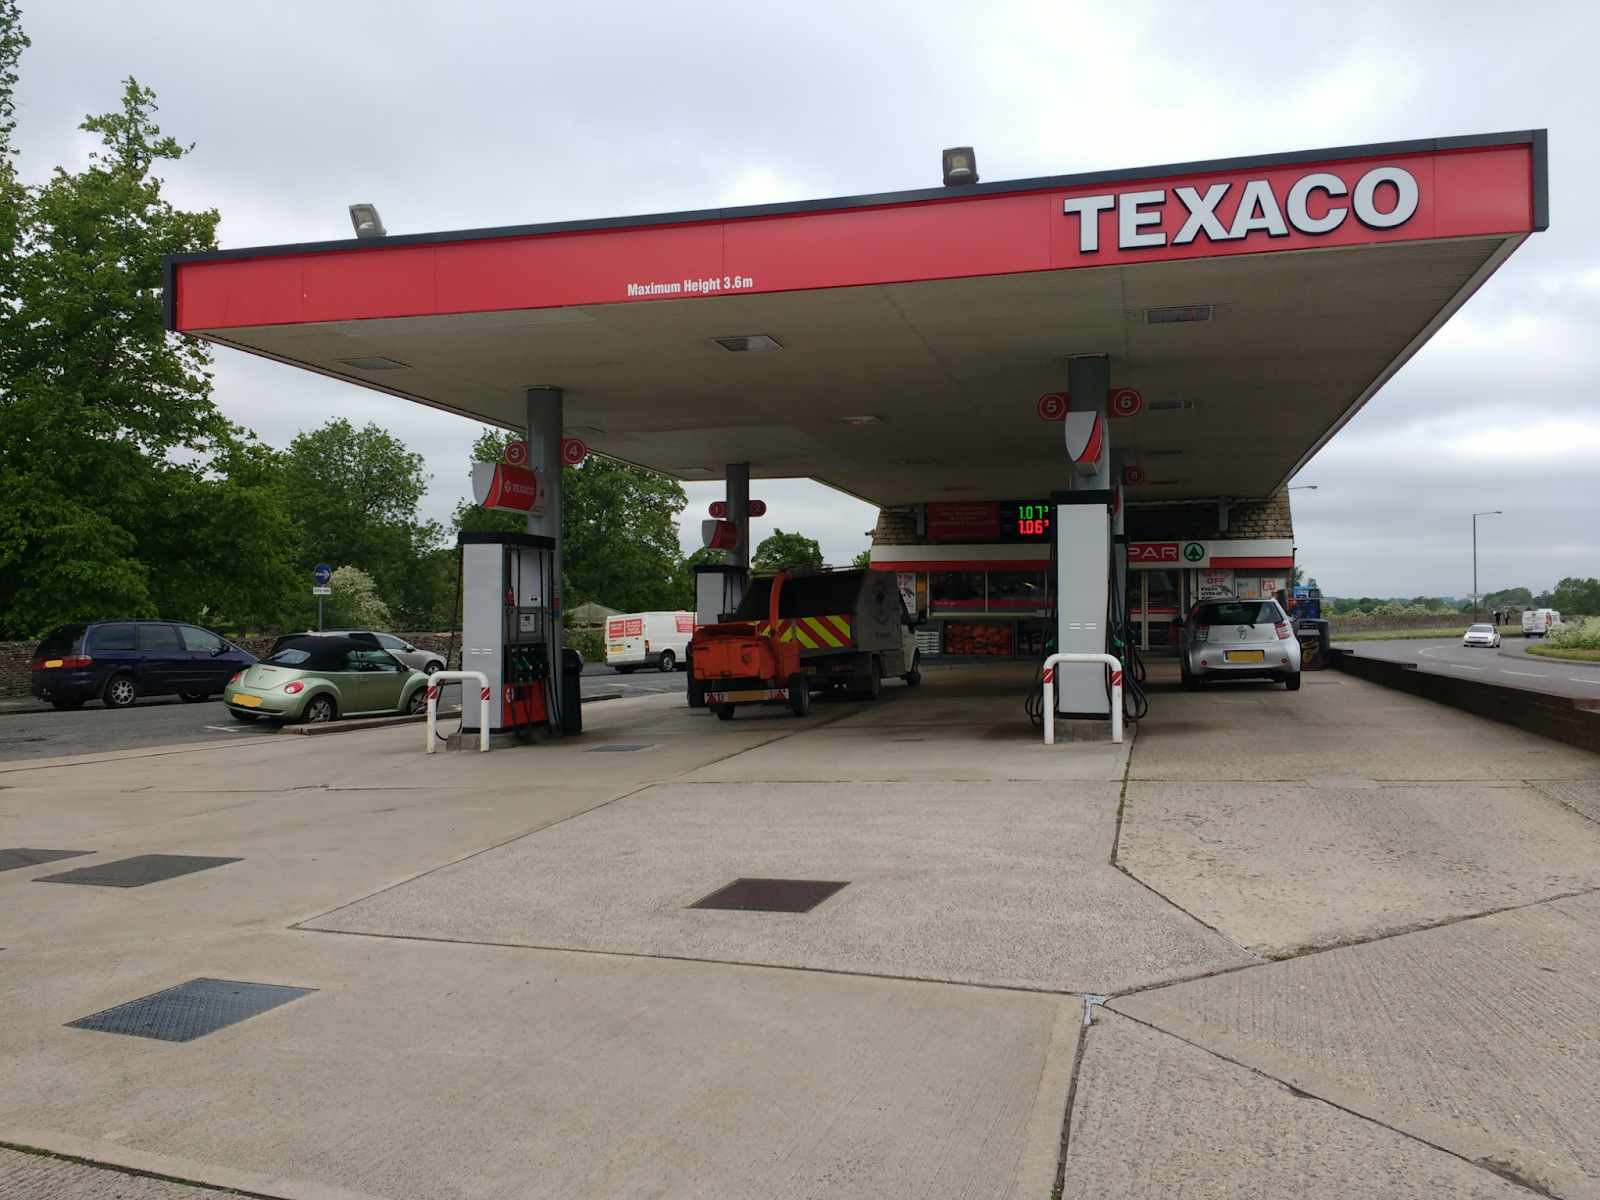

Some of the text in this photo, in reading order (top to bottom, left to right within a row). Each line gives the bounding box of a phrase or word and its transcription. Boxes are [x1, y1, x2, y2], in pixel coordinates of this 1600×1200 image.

[1063, 166, 1421, 254] TEXACO
[627, 276, 753, 297] Maximum Height 3.6m
[1046, 400, 1058, 413] 5
[1120, 395, 1132, 409] 6
[511, 447, 520, 460] 3
[569, 445, 579, 457] 4
[512, 483, 535, 496] TEXACO
[539, 488, 545, 499] 4
[713, 505, 719, 514] 1
[754, 505, 762, 513] 2
[1128, 546, 1178, 559] PAR
[1201, 570, 1219, 578] GET
